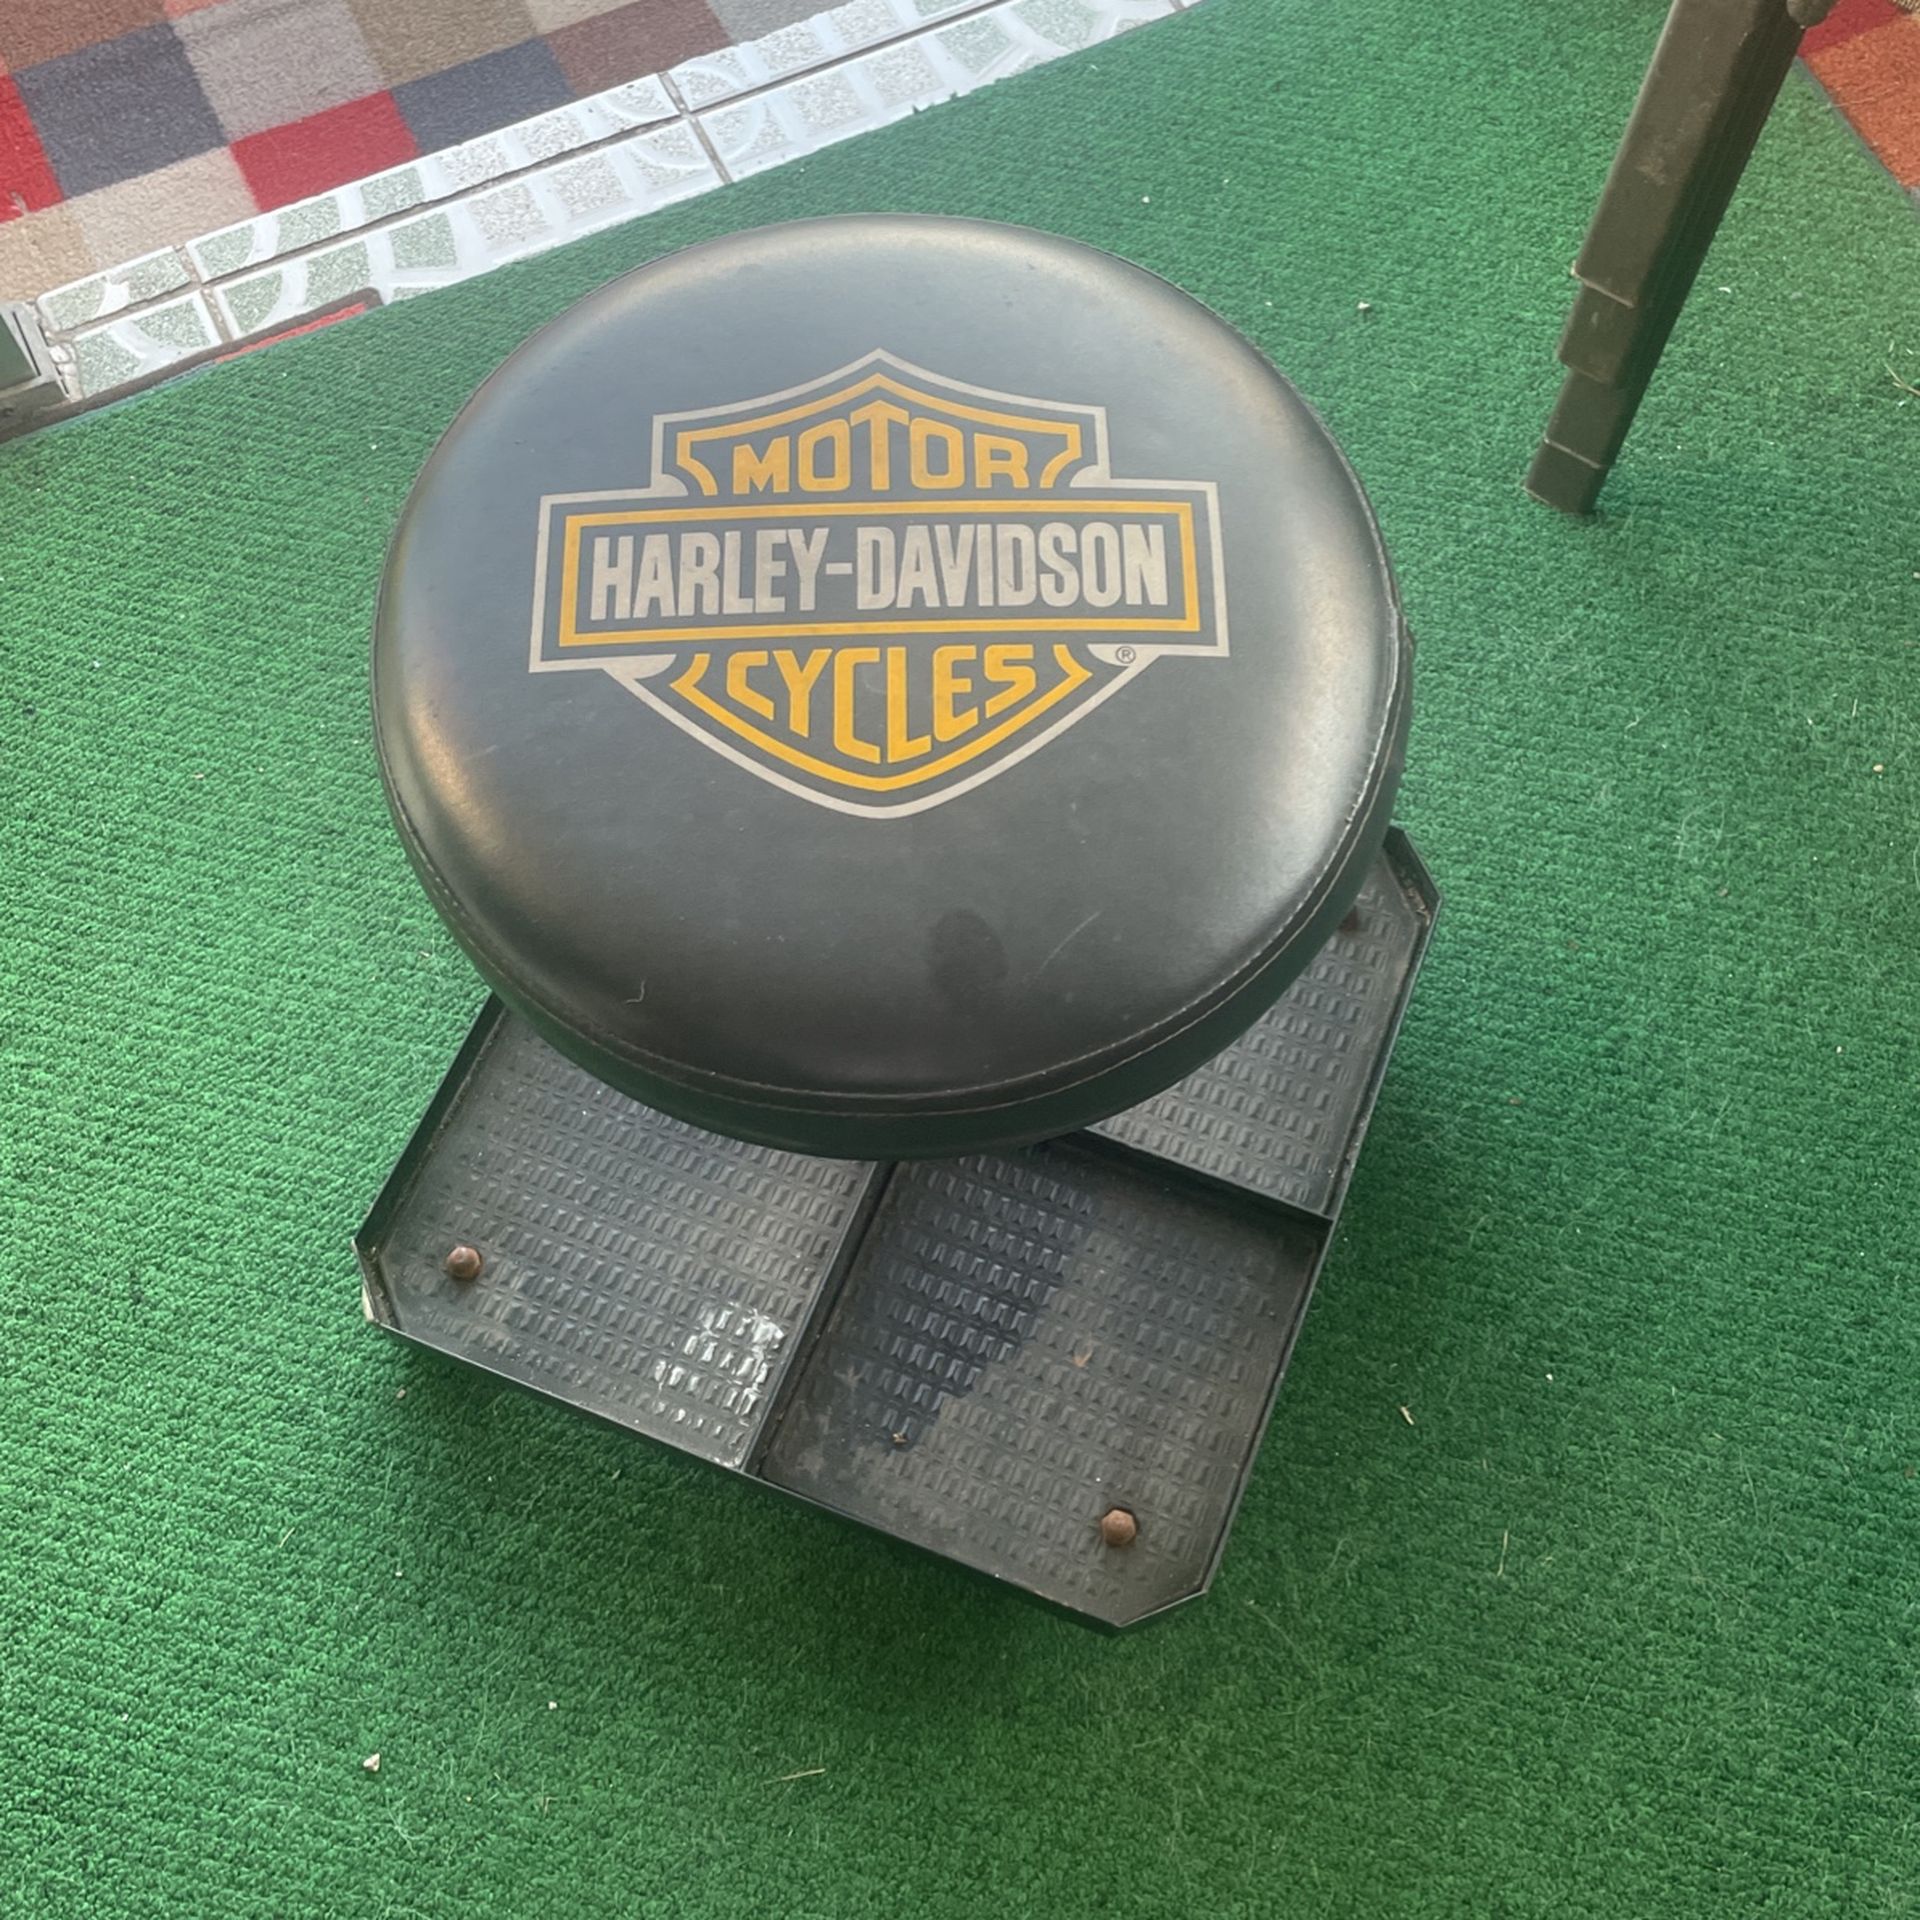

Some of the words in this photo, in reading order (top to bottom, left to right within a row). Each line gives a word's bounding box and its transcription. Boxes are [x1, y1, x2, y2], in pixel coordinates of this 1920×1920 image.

[732, 399, 1030, 495] MOTOR
[589, 521, 1169, 621] HARLEY-DAVIDSON
[726, 643, 1036, 764] CYCLES
